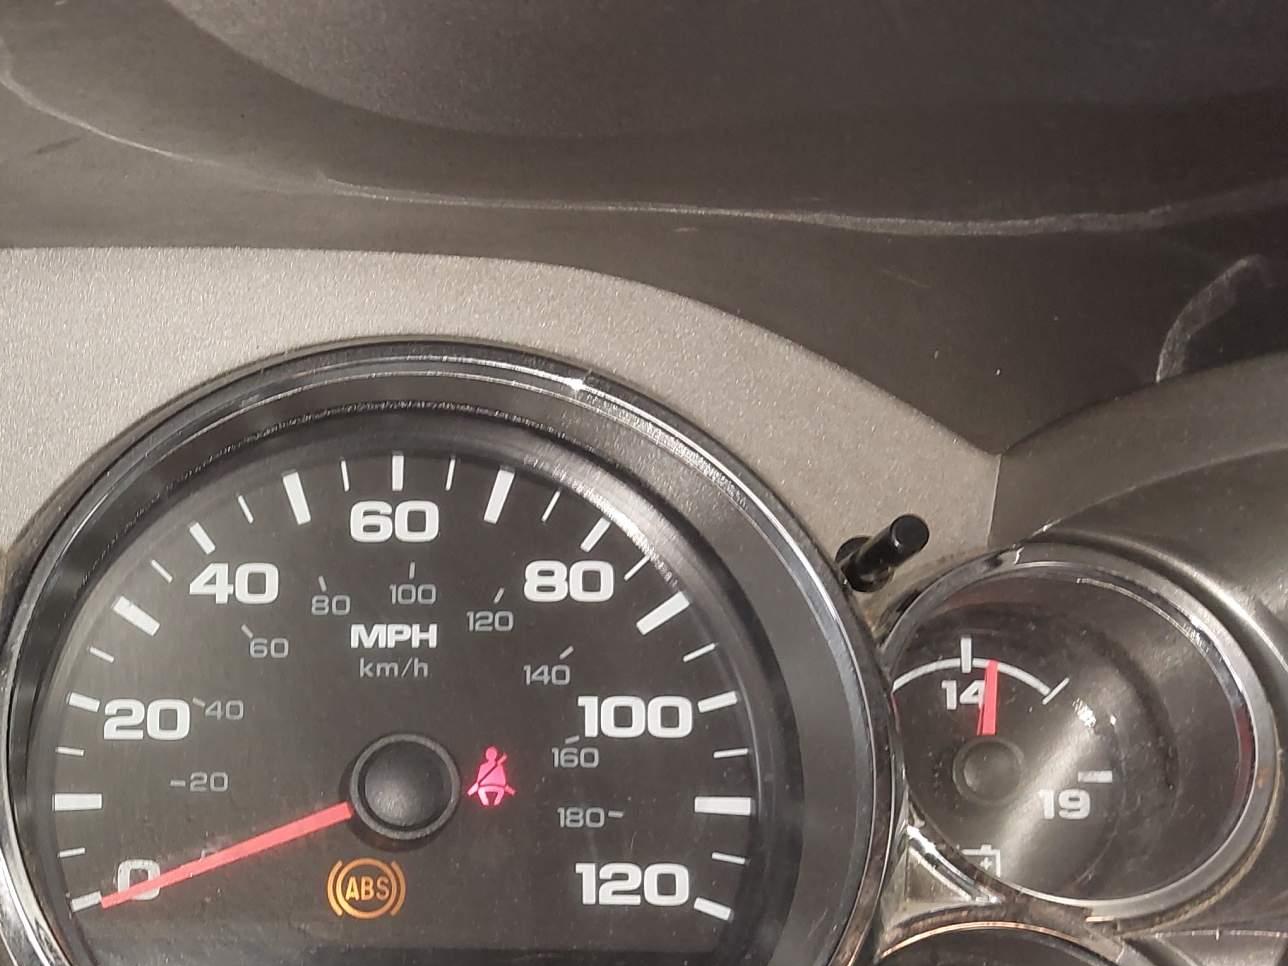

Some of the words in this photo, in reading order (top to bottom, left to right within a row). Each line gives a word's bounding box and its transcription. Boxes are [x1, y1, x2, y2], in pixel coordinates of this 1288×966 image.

[349, 501, 440, 542] 60
[189, 563, 279, 604] 40
[523, 560, 614, 602] 80
[311, 594, 351, 616] 80
[388, 583, 437, 604] 100
[466, 610, 514, 632] 120
[249, 637, 289, 658] 60
[349, 624, 438, 648] MPH
[358, 660, 429, 679] km/h
[523, 665, 571, 686] 140
[103, 698, 191, 740] 20
[204, 700, 244, 721] 40
[577, 697, 693, 738] 100
[551, 747, 599, 769] 160
[188, 772, 229, 792] 20
[1038, 789, 1091, 820] 19
[557, 808, 605, 829] 180
[117, 859, 161, 900] 0
[344, 876, 391, 901] ABS
[575, 863, 690, 906] 120
